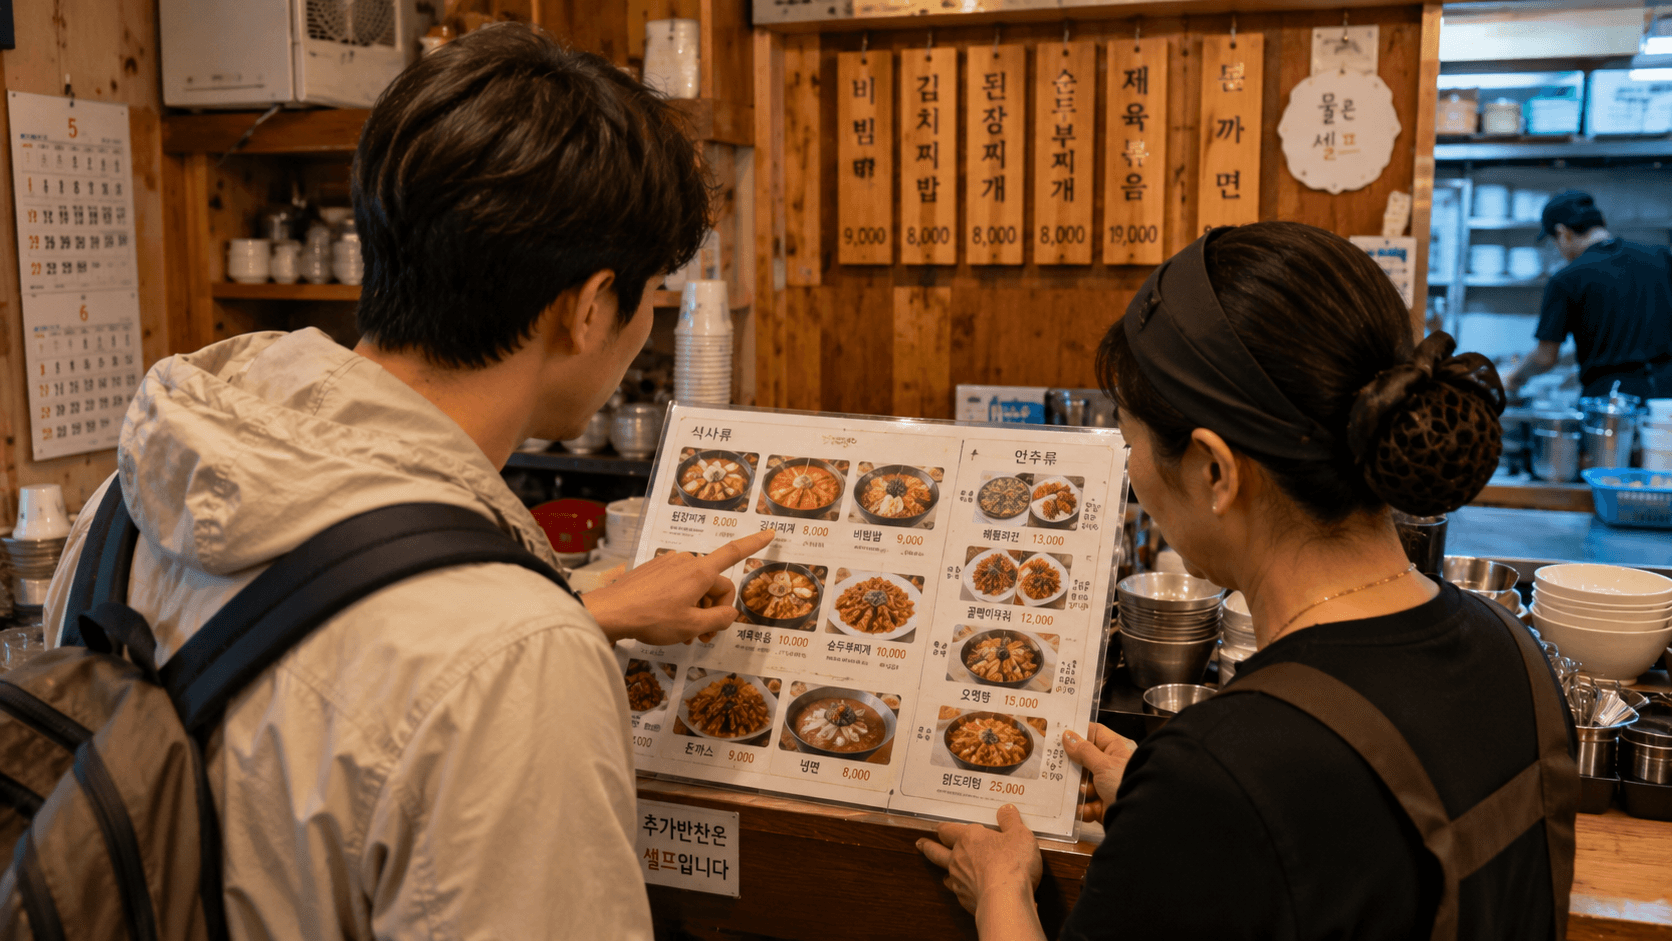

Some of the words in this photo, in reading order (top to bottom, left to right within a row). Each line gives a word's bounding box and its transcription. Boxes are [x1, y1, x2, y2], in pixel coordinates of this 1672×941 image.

[68, 117, 78, 139] 5
[981, 71, 1007, 203] 된장찌개
[844, 226, 886, 247] 9,000
[906, 226, 950, 247] 8,000
[972, 225, 1017, 247] 8,000
[1040, 225, 1085, 247] 8,000
[1109, 224, 1158, 247] 19,000
[79, 304, 89, 322] 6
[691, 426, 732, 442] 식사류
[802, 525, 829, 537] 8,000
[896, 533, 923, 546] 9,000
[1032, 533, 1065, 546] 13,000
[1020, 612, 1054, 626] 12,000
[876, 646, 906, 660] 10,000
[1004, 694, 1039, 710] 15,000
[684, 742, 713, 757] 돈까스
[842, 766, 871, 781] 8,000
[988, 780, 1025, 796] 25,000
